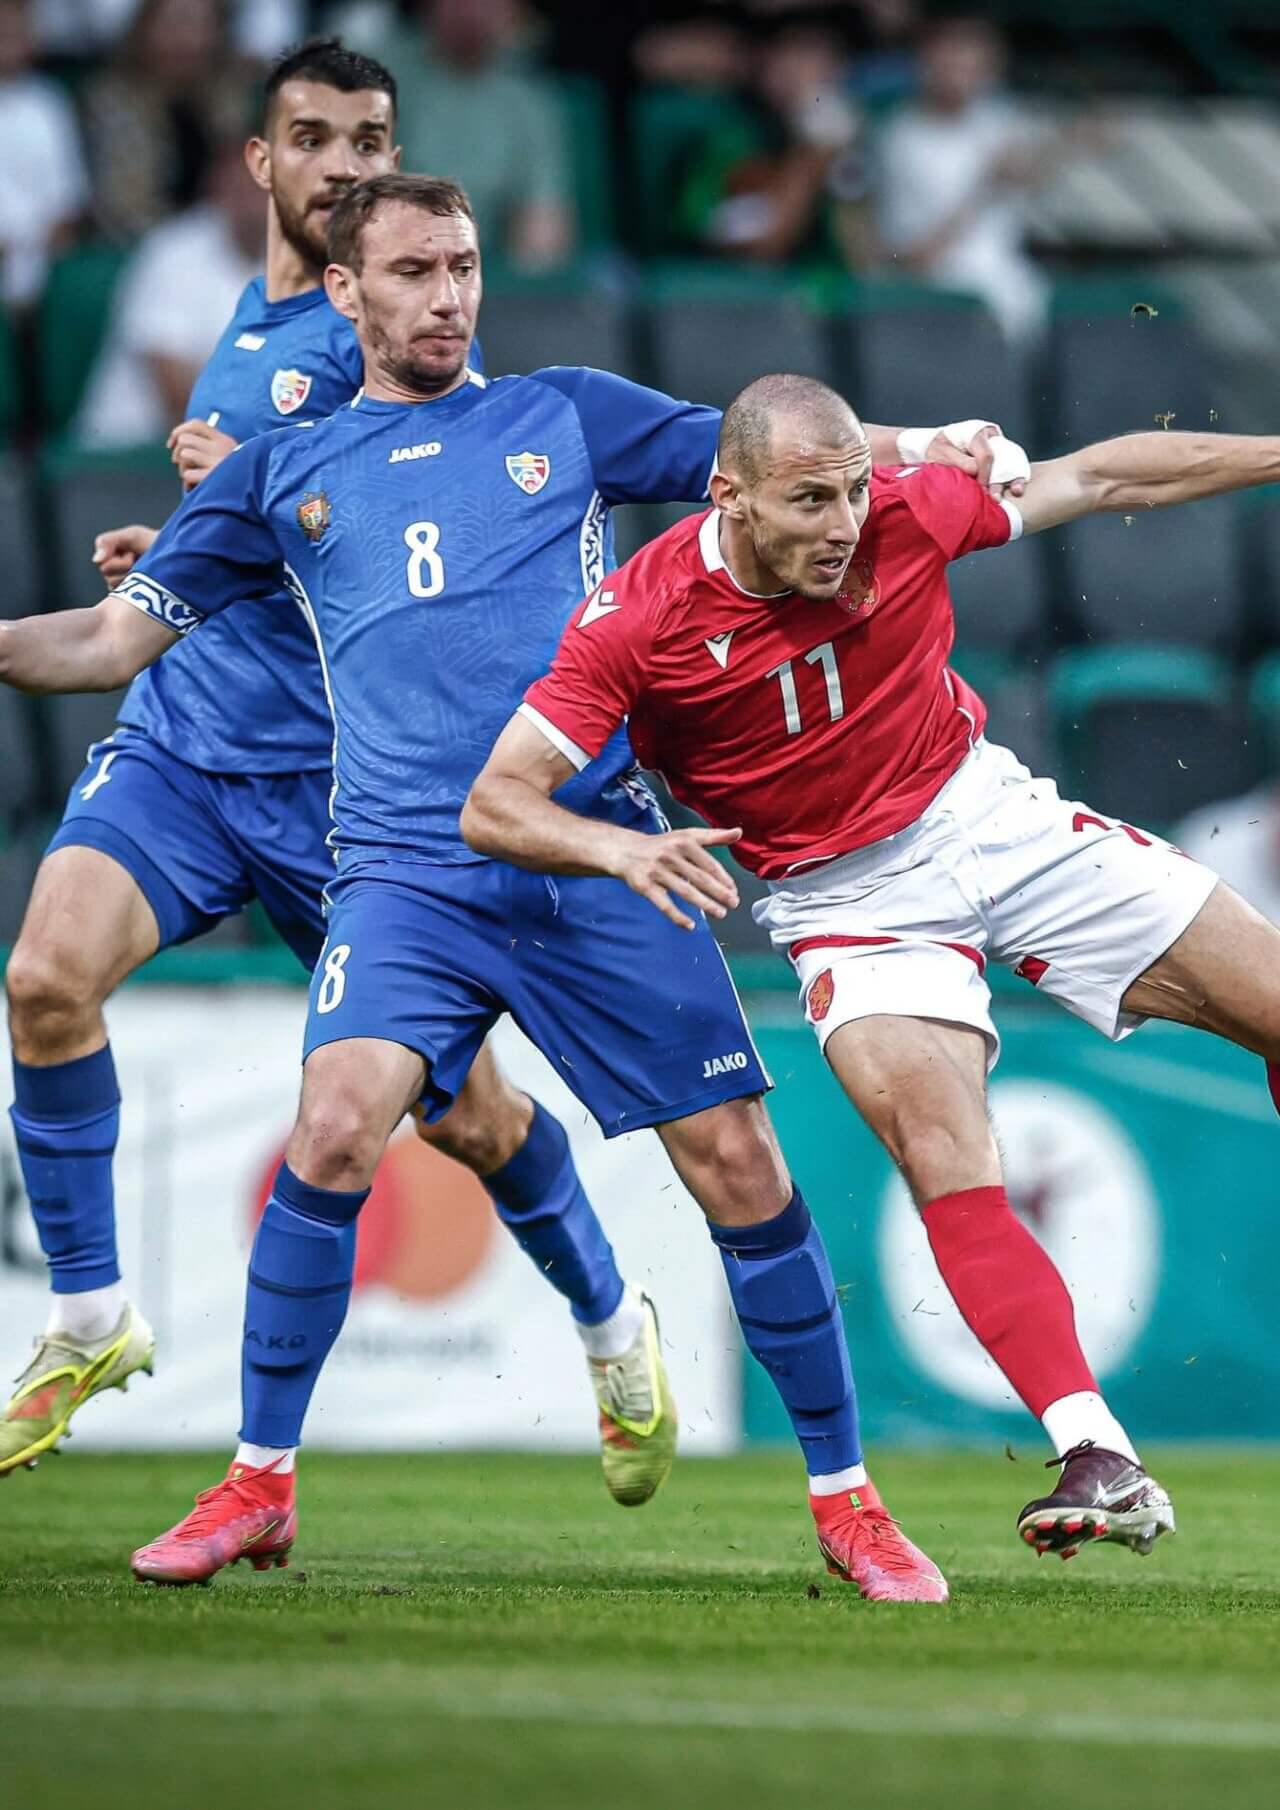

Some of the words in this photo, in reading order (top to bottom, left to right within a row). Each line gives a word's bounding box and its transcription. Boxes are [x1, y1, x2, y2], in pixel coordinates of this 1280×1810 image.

[388, 441, 442, 464] JAKO
[404, 521, 445, 598] 8
[764, 641, 844, 735] 11
[317, 944, 352, 1014] 8
[703, 1051, 748, 1078] JAKO
[244, 1329, 307, 1349] AKO
